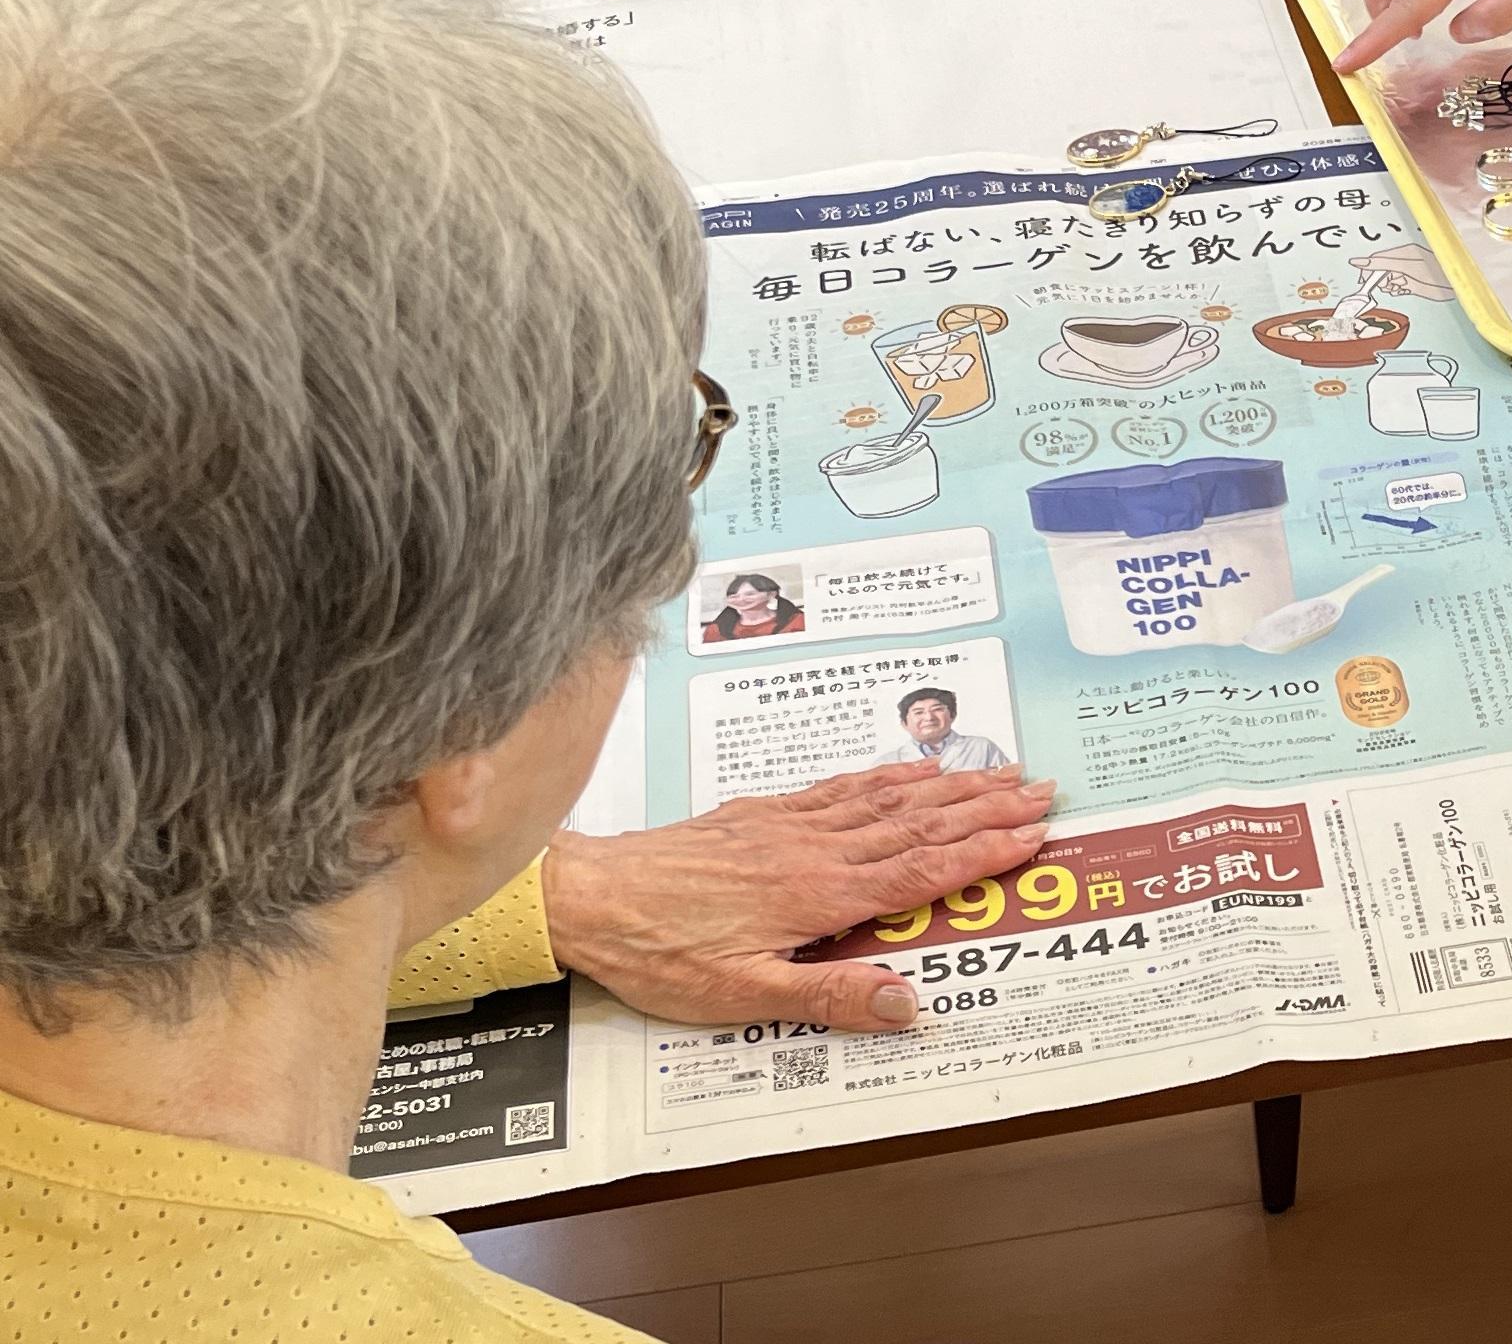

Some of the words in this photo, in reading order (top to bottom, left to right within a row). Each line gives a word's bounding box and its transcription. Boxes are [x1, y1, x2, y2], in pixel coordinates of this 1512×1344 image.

[752, 222, 1425, 303] 毎日コラーゲンを飲んでい
[1116, 549, 1211, 574] NIPPI
[1120, 567, 1251, 595] COLLA-
[1126, 591, 1203, 616] GEN
[1133, 614, 1197, 636] 100
[757, 671, 938, 705] 世界品質のコラーゲン。
[1076, 680, 1320, 721] ニッピコラーゲン100
[1439, 799, 1487, 927] ニッピコラーゲン100
[1219, 893, 1297, 909] EUNP199
[1475, 946, 1496, 978] 8533
[672, 1039, 700, 1049] FAX
[845, 1075, 898, 1093] 株式会社
[902, 1041, 1084, 1083] ニッピコラーゲン化粧品
